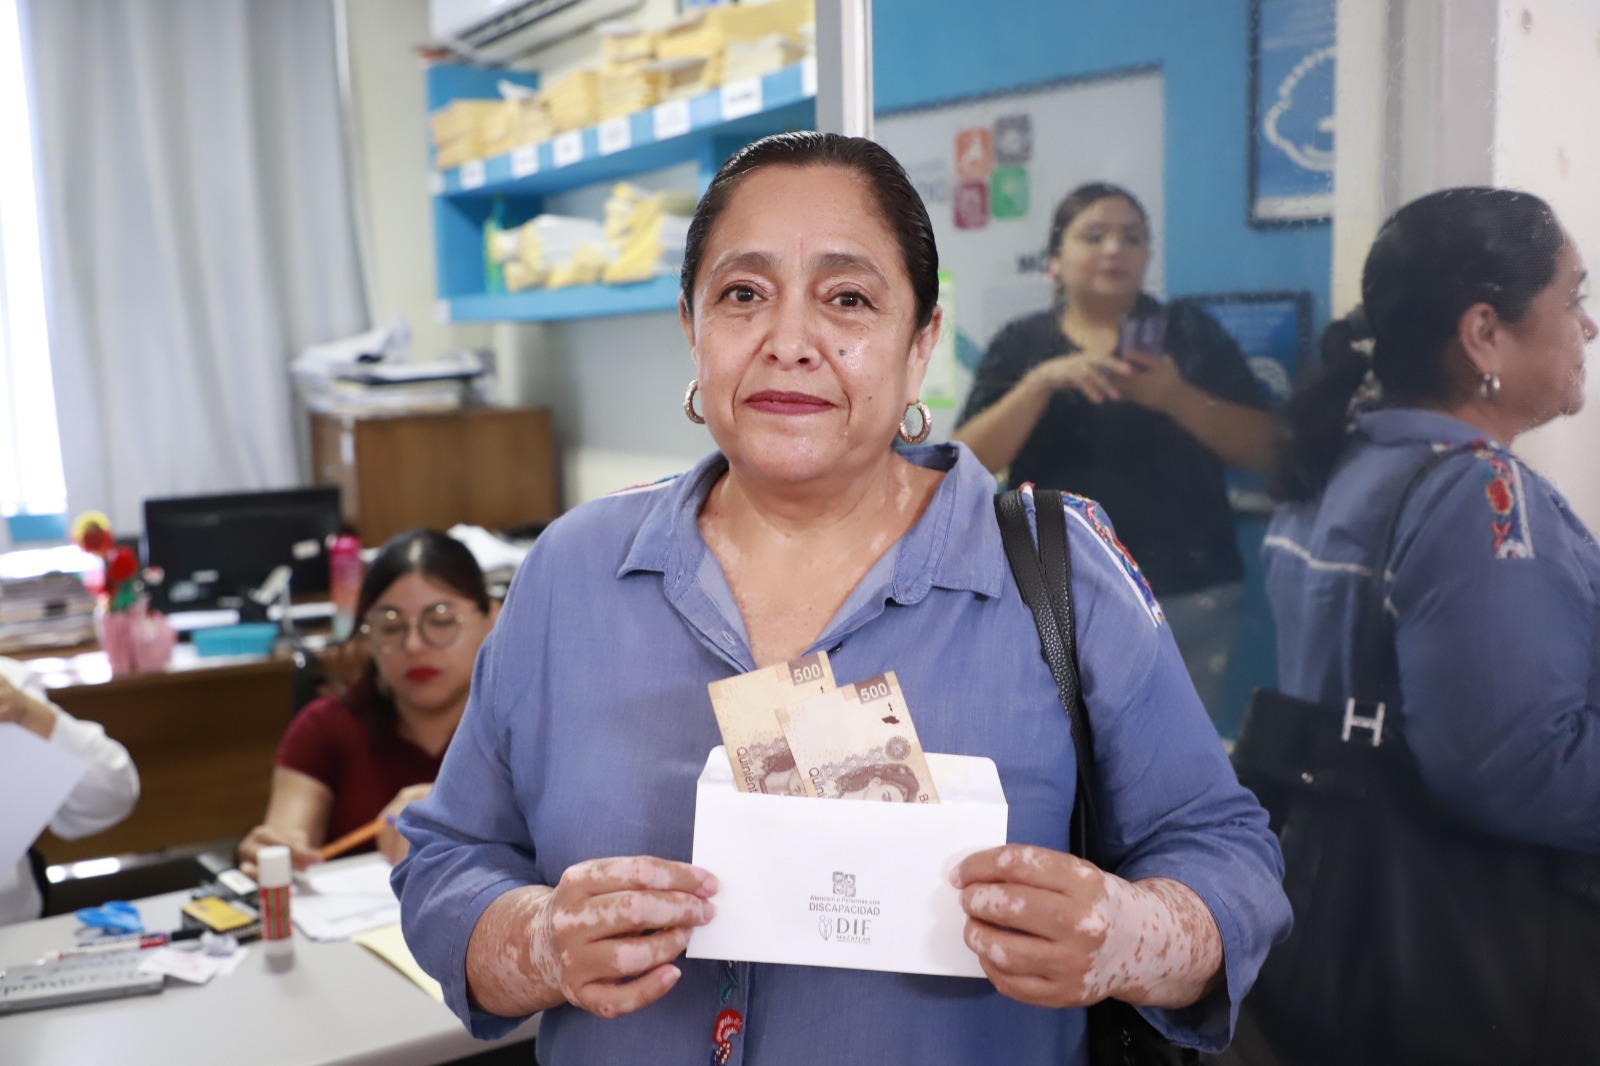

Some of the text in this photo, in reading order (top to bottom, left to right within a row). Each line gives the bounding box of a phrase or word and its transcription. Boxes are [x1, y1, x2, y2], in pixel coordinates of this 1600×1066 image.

[794, 664, 821, 683] 500
[860, 682, 888, 702] 500
[809, 902, 880, 916] DISCAPACIDAD
[836, 917, 872, 935] DIF
